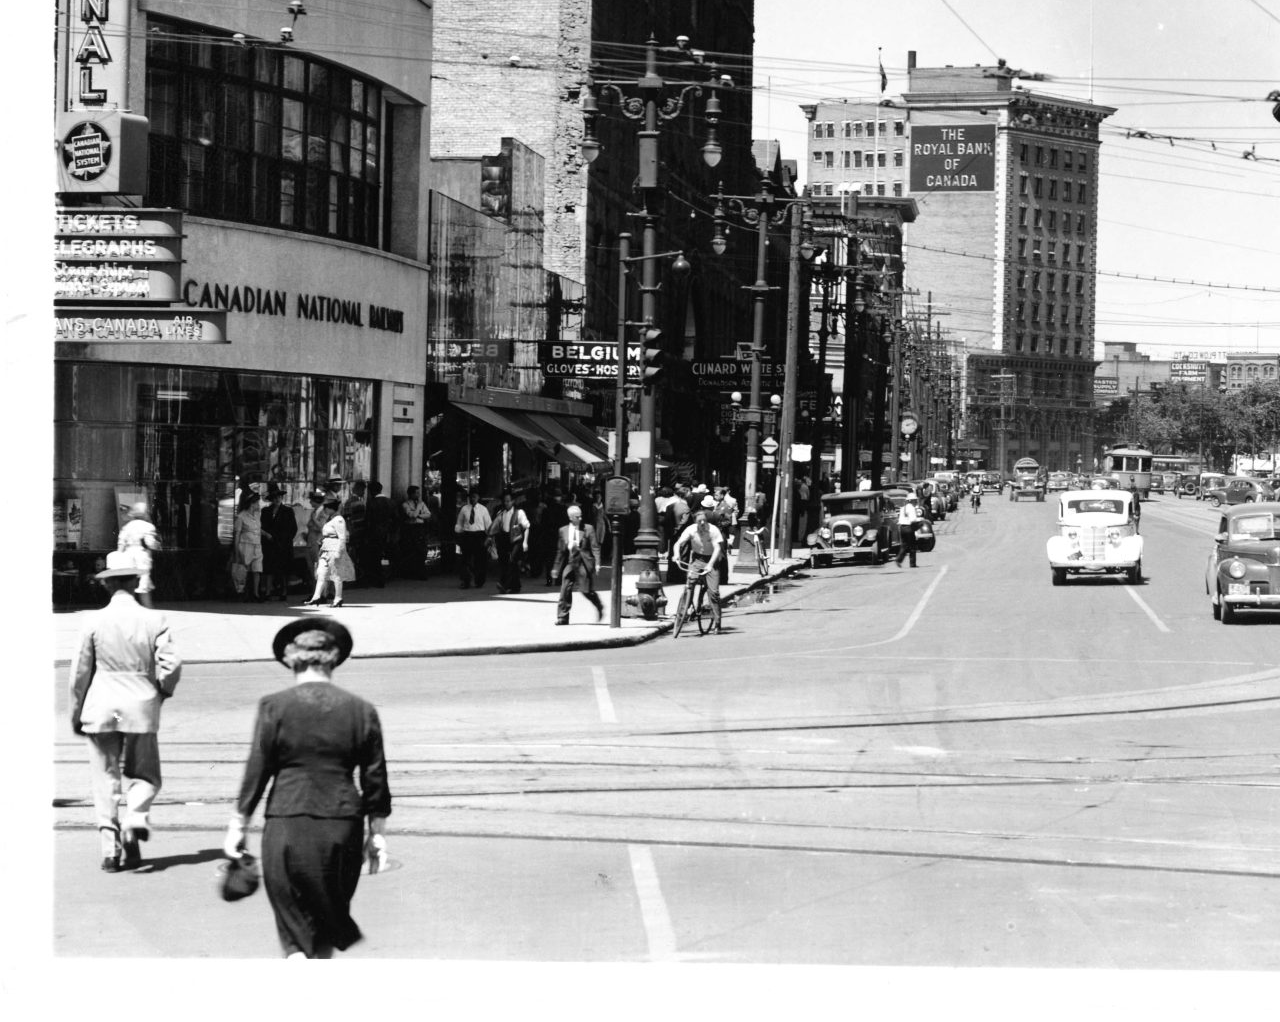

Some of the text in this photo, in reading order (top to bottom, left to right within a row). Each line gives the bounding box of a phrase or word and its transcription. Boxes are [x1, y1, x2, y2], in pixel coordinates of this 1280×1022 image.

[940, 129, 965, 141] THE
[914, 142, 992, 156] ROYAL BANK
[76, 157, 100, 166] SYSTEM
[943, 158, 960, 171] OF
[926, 175, 978, 188] CANADA
[55, 214, 139, 230] TICKETS
[183, 279, 287, 317] CANADIAN
[297, 293, 364, 327] NATIONAL
[173, 316, 193, 325] AIR
[165, 325, 201, 337] LINES
[692, 363, 737, 375] CUNARD
[741, 363, 772, 374] WTE
